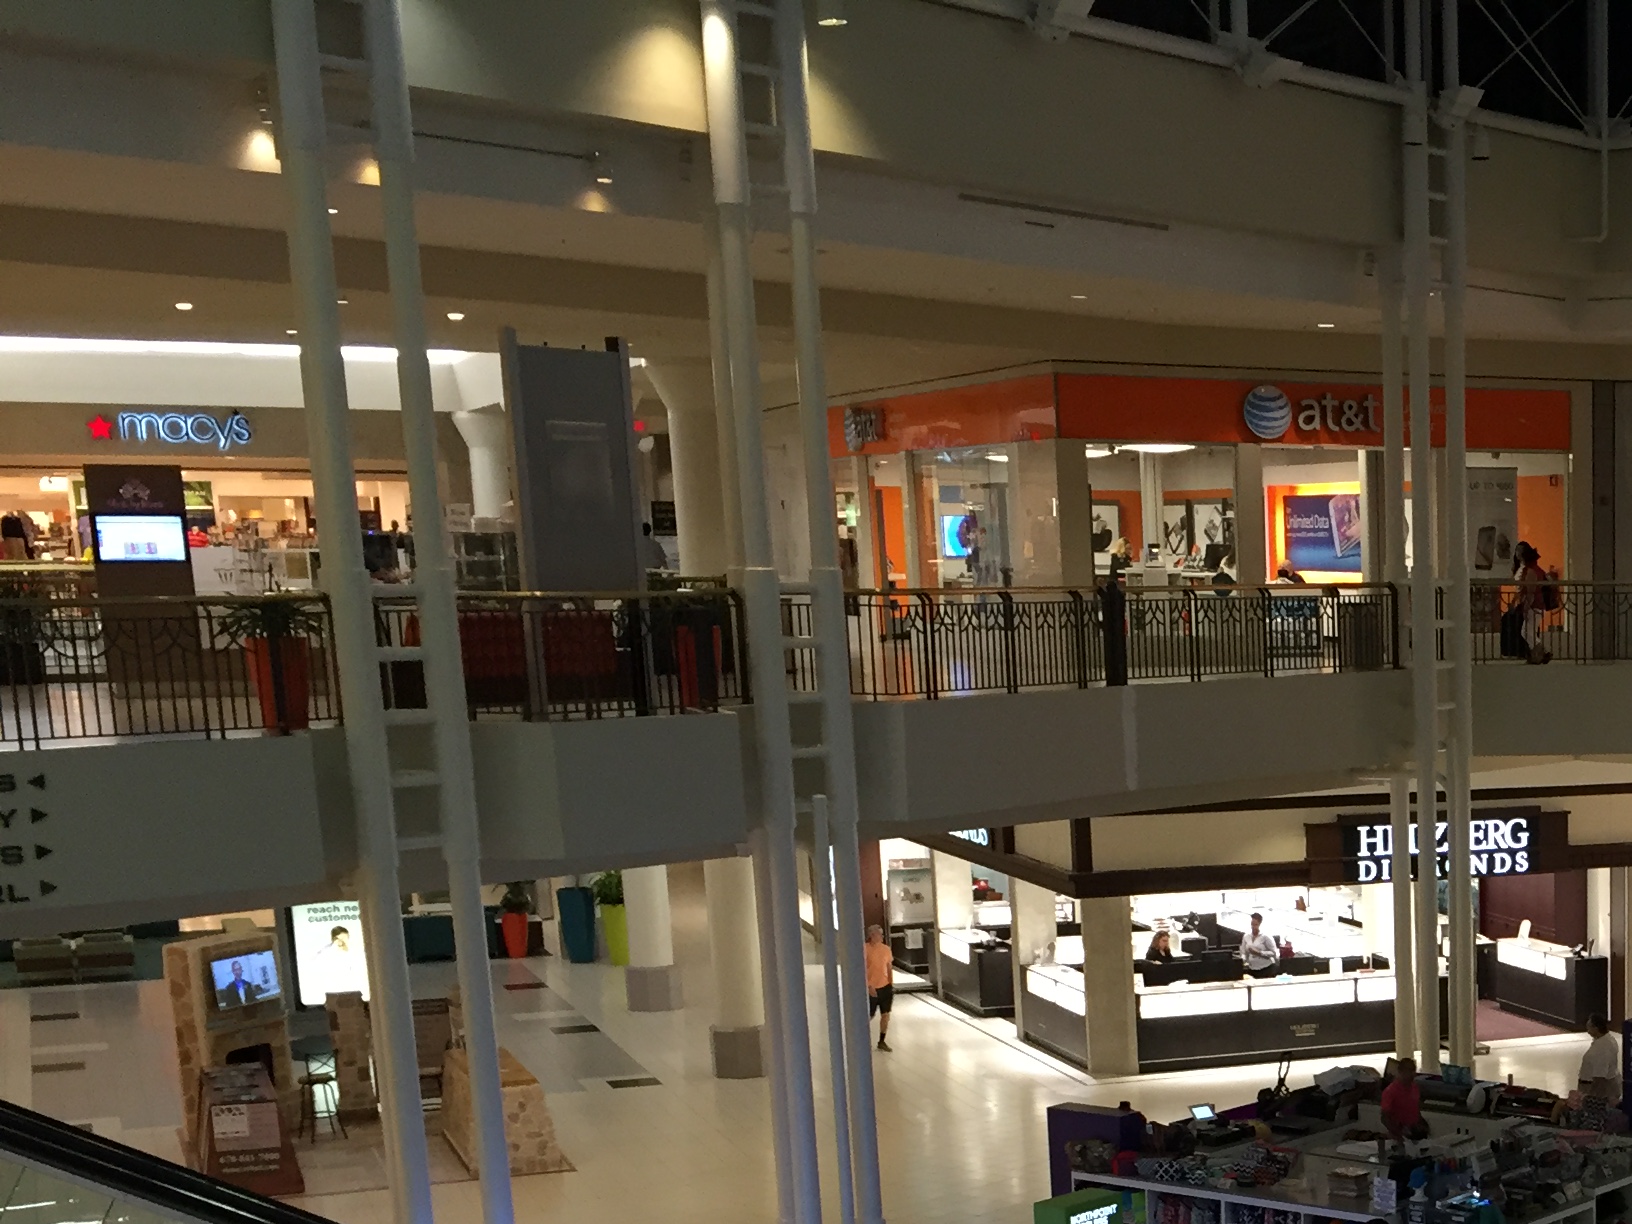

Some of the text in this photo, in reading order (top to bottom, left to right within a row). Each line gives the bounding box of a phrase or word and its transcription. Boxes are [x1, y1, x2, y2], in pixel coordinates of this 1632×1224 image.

[1298, 392, 1381, 433] at&t
[1357, 818, 1529, 857] HLZERG
[1357, 851, 1529, 881] DINDS
[307, 904, 341, 914] reach
